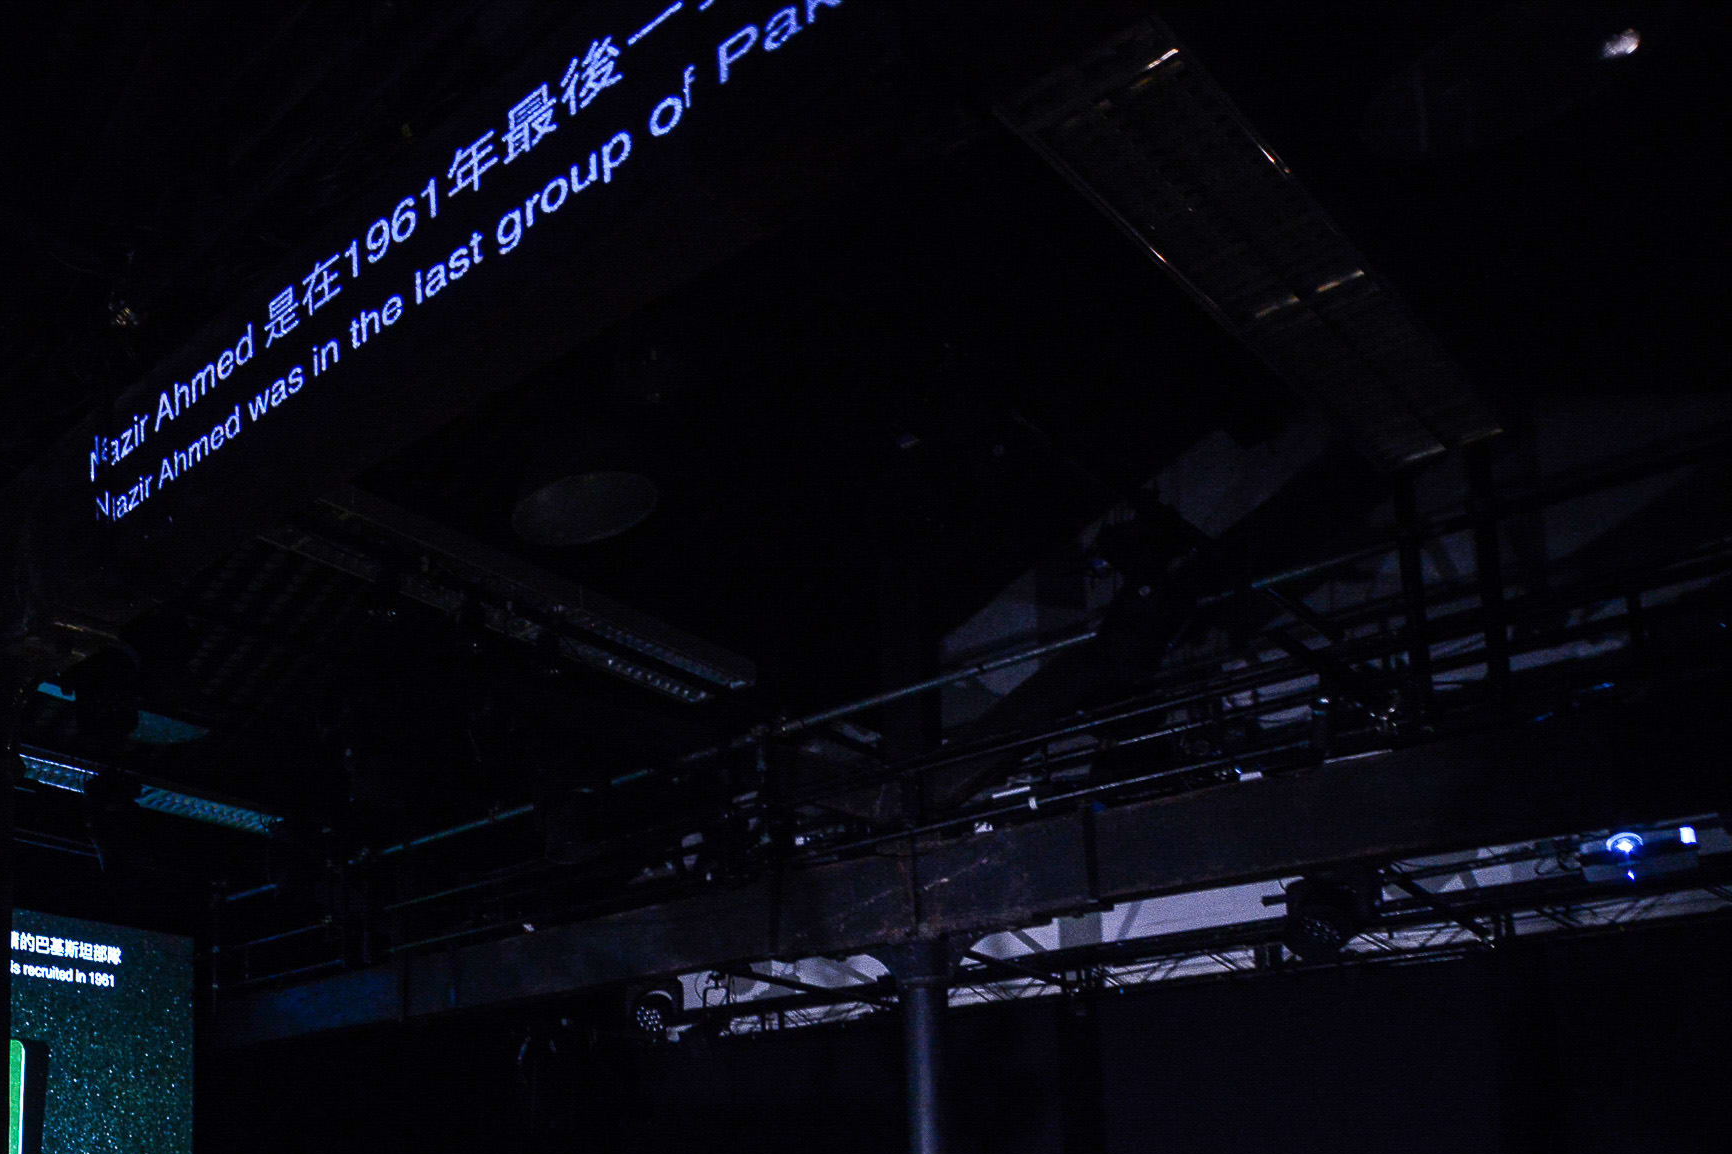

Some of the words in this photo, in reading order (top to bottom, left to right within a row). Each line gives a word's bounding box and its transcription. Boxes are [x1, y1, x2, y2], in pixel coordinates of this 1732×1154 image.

[90, 414, 150, 482] Nazir
[154, 322, 254, 432] Ahmed
[264, 0, 715, 349] 是在1961年最後一
[95, 475, 153, 521] Nazir
[158, 404, 241, 490] Ahmed
[248, 365, 304, 422] was
[312, 338, 340, 377] in
[349, 293, 404, 349] the
[415, 230, 484, 305] last
[496, 131, 632, 255] group
[649, 64, 696, 136] of
[22, 963, 74, 982] recruited
[75, 968, 87, 984] in
[88, 971, 115, 988] 1961
